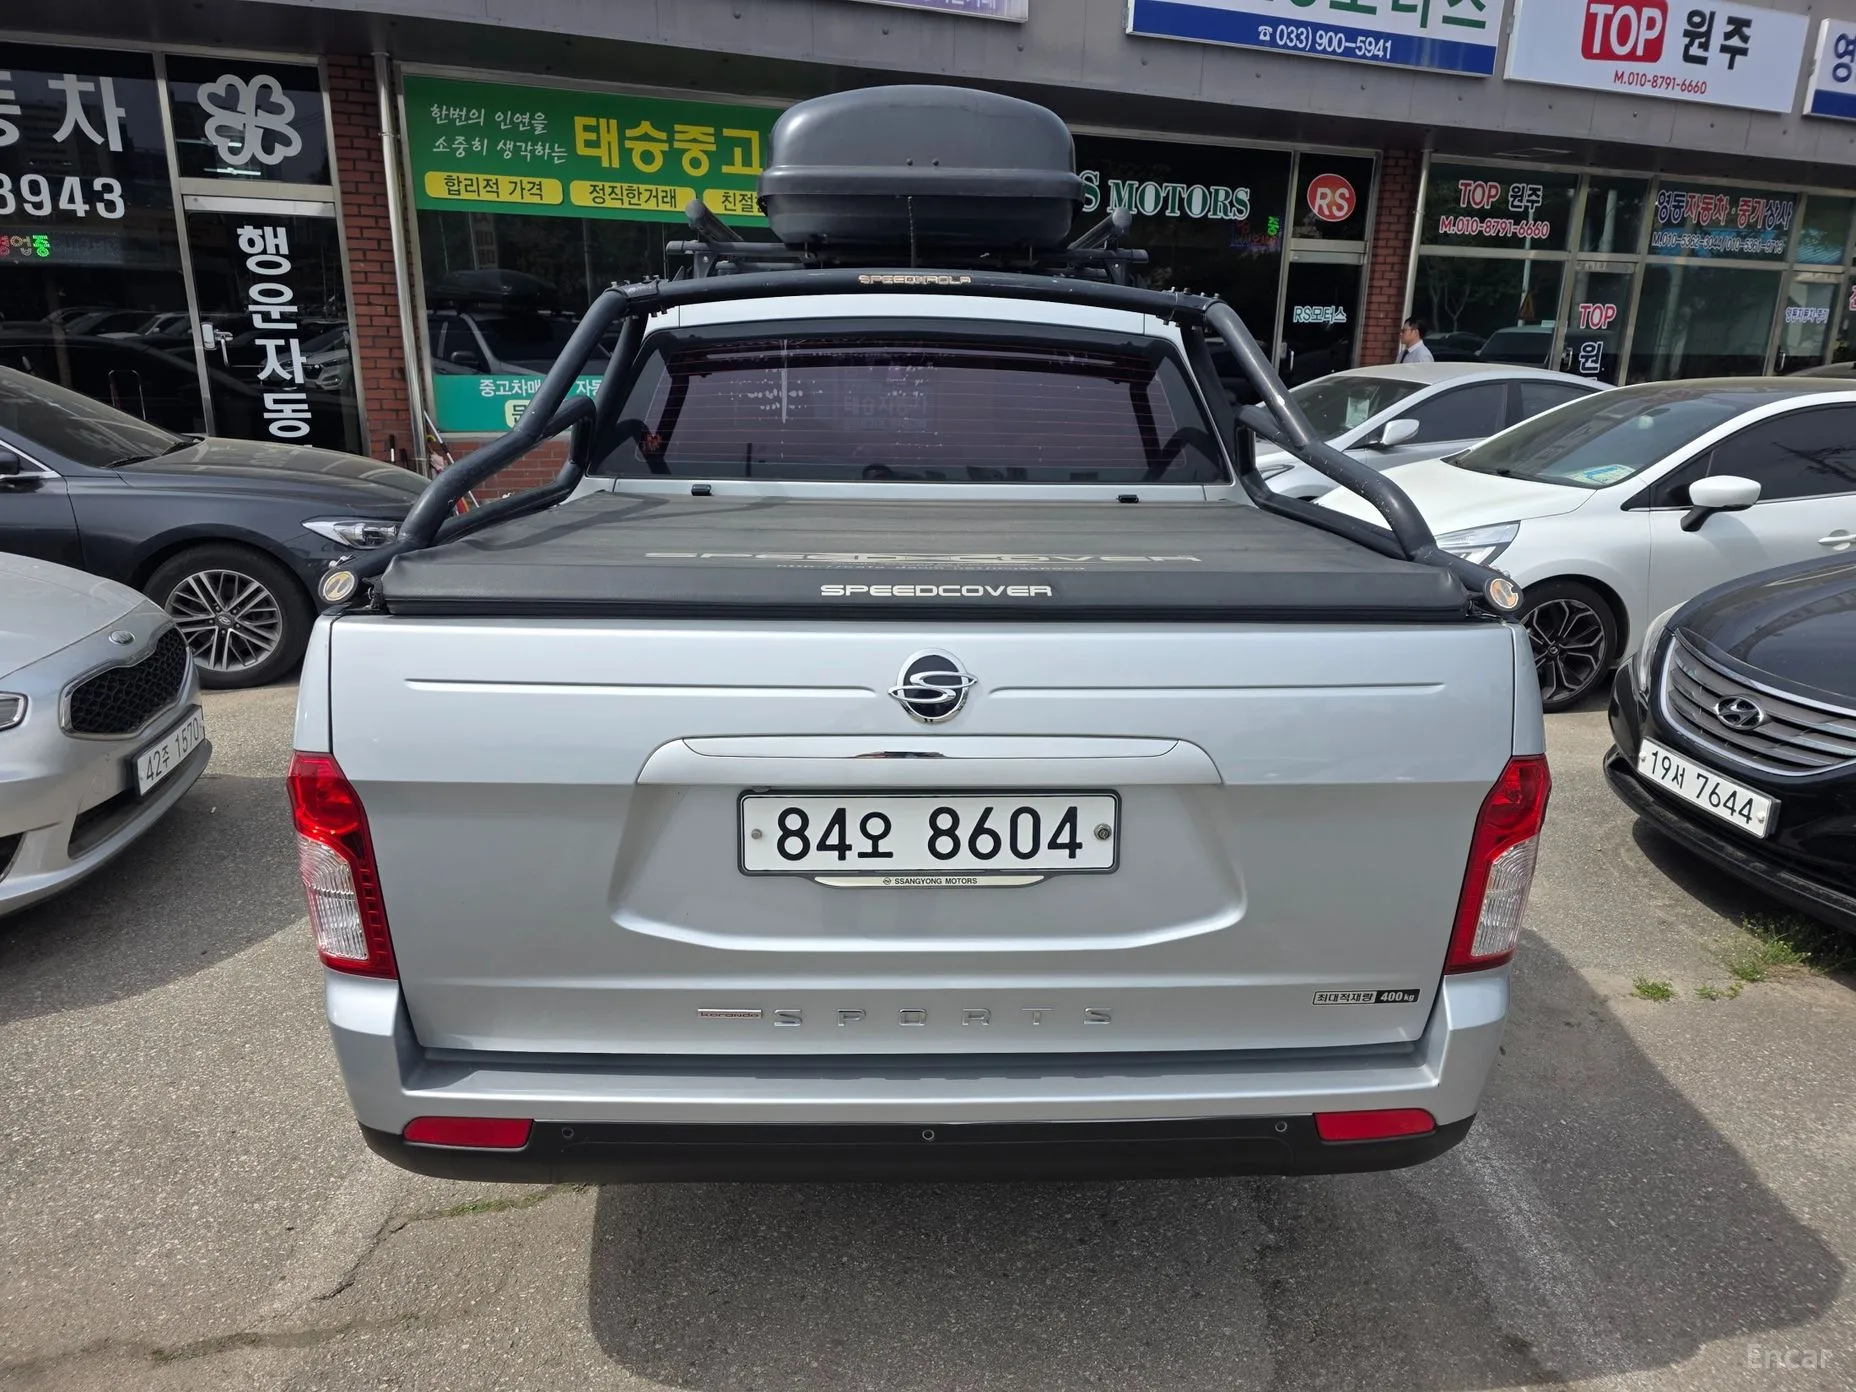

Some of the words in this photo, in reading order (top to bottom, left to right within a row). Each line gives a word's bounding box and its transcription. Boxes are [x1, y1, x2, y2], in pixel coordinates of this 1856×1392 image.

[1587, 2, 1665, 57] TOP
[1682, 9, 1753, 70] 원주
[1613, 70, 1708, 95] M.010-8791-6660
[430, 104, 485, 126] 한번의
[494, 110, 548, 135] 인연을
[433, 135, 488, 158] 소중히
[497, 139, 568, 164] 생각하는
[574, 116, 764, 177] 태승중고
[443, 174, 501, 199] 합리적
[508, 180, 544, 201] 가격
[589, 183, 678, 208] 정직한거래
[1079, 169, 1101, 213] S
[1107, 179, 1251, 221] MOTORS
[1459, 180, 1501, 209] TOP
[1508, 183, 1543, 212] 원주
[721, 191, 762, 213] 친절
[1314, 187, 1351, 217] RS
[1439, 215, 1551, 239] M.010-8791-6660
[1292, 305, 1348, 324] RS모터스
[1579, 303, 1617, 329] TOP
[236, 225, 313, 447] 행운자동
[820, 584, 1053, 597] SPEEDCOVER
[146, 744, 170, 781] 42주
[175, 717, 200, 758] 1570
[1651, 750, 1686, 790] 19서
[1695, 772, 1754, 824] 7644
[776, 806, 894, 862] 84오
[926, 806, 1084, 862] 8604
[894, 877, 943, 885] SSANGYONG
[945, 877, 978, 885] MOTORS
[1317, 993, 1374, 1003] 최대적재량
[773, 1007, 1113, 1028] SPORTS
